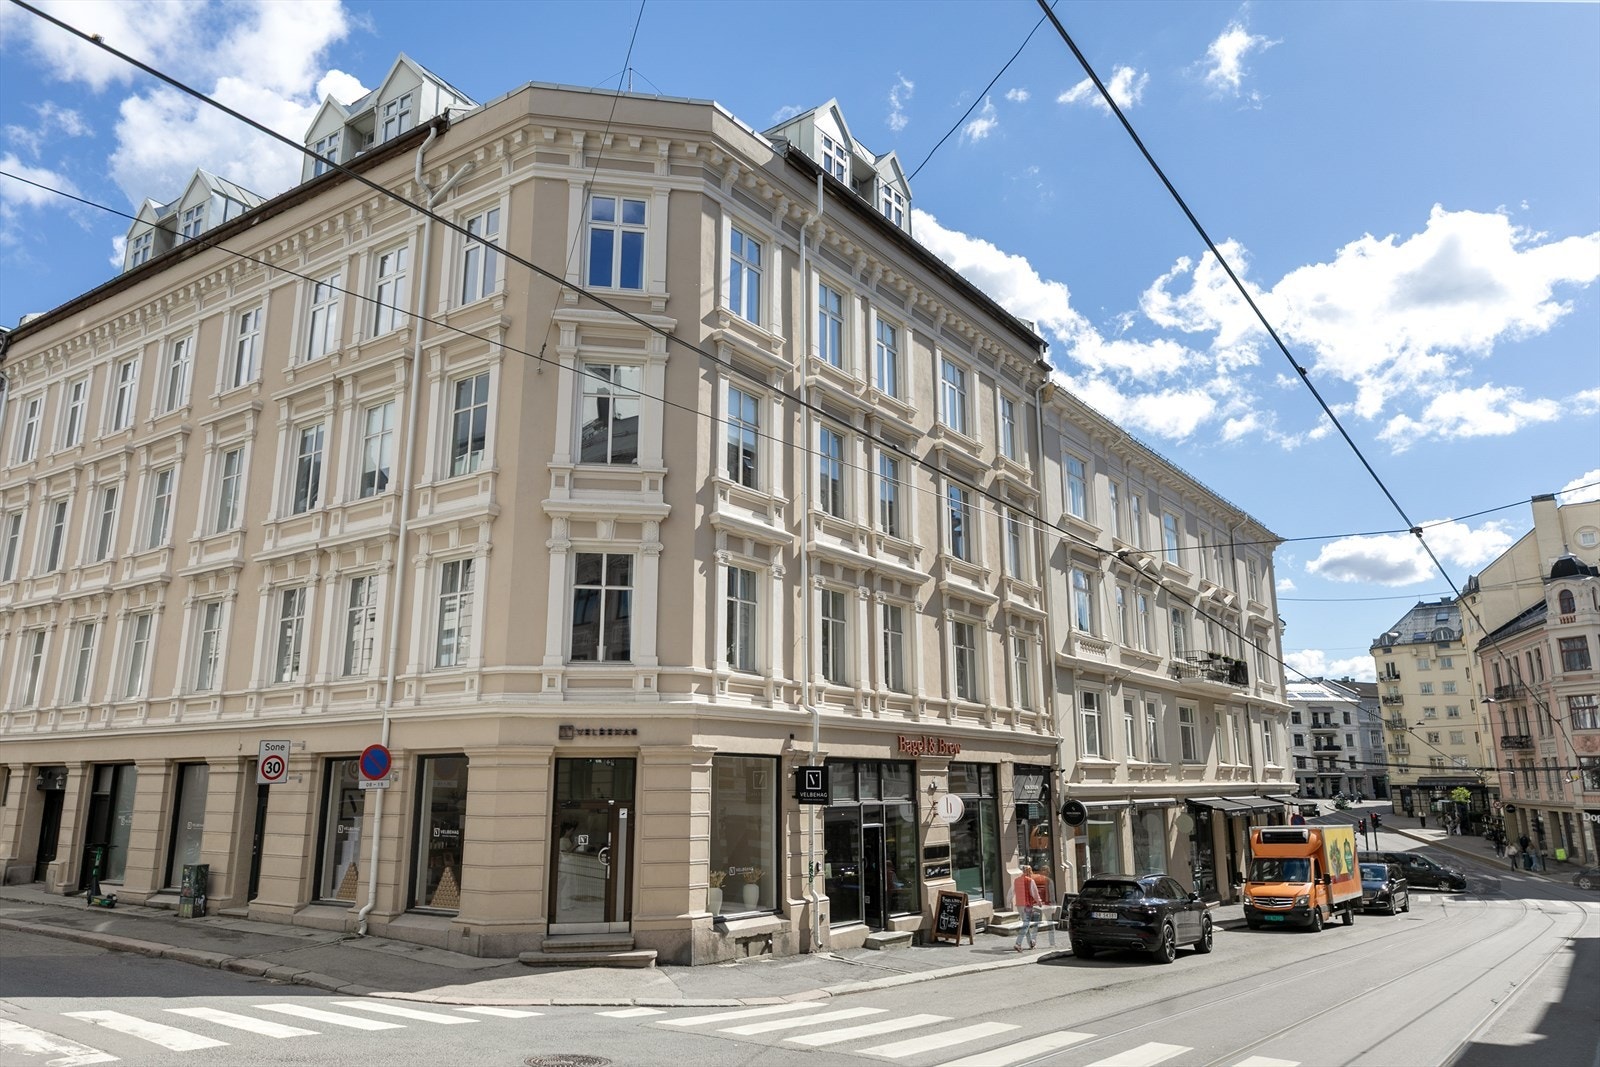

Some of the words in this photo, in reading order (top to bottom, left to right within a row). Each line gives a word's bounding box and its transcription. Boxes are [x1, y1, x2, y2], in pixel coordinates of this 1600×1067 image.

[265, 743, 285, 752] Sone
[898, 735, 927, 757] Bagel
[928, 736, 935, 754] &
[937, 737, 961, 755] Brew
[265, 761, 281, 774] 30
